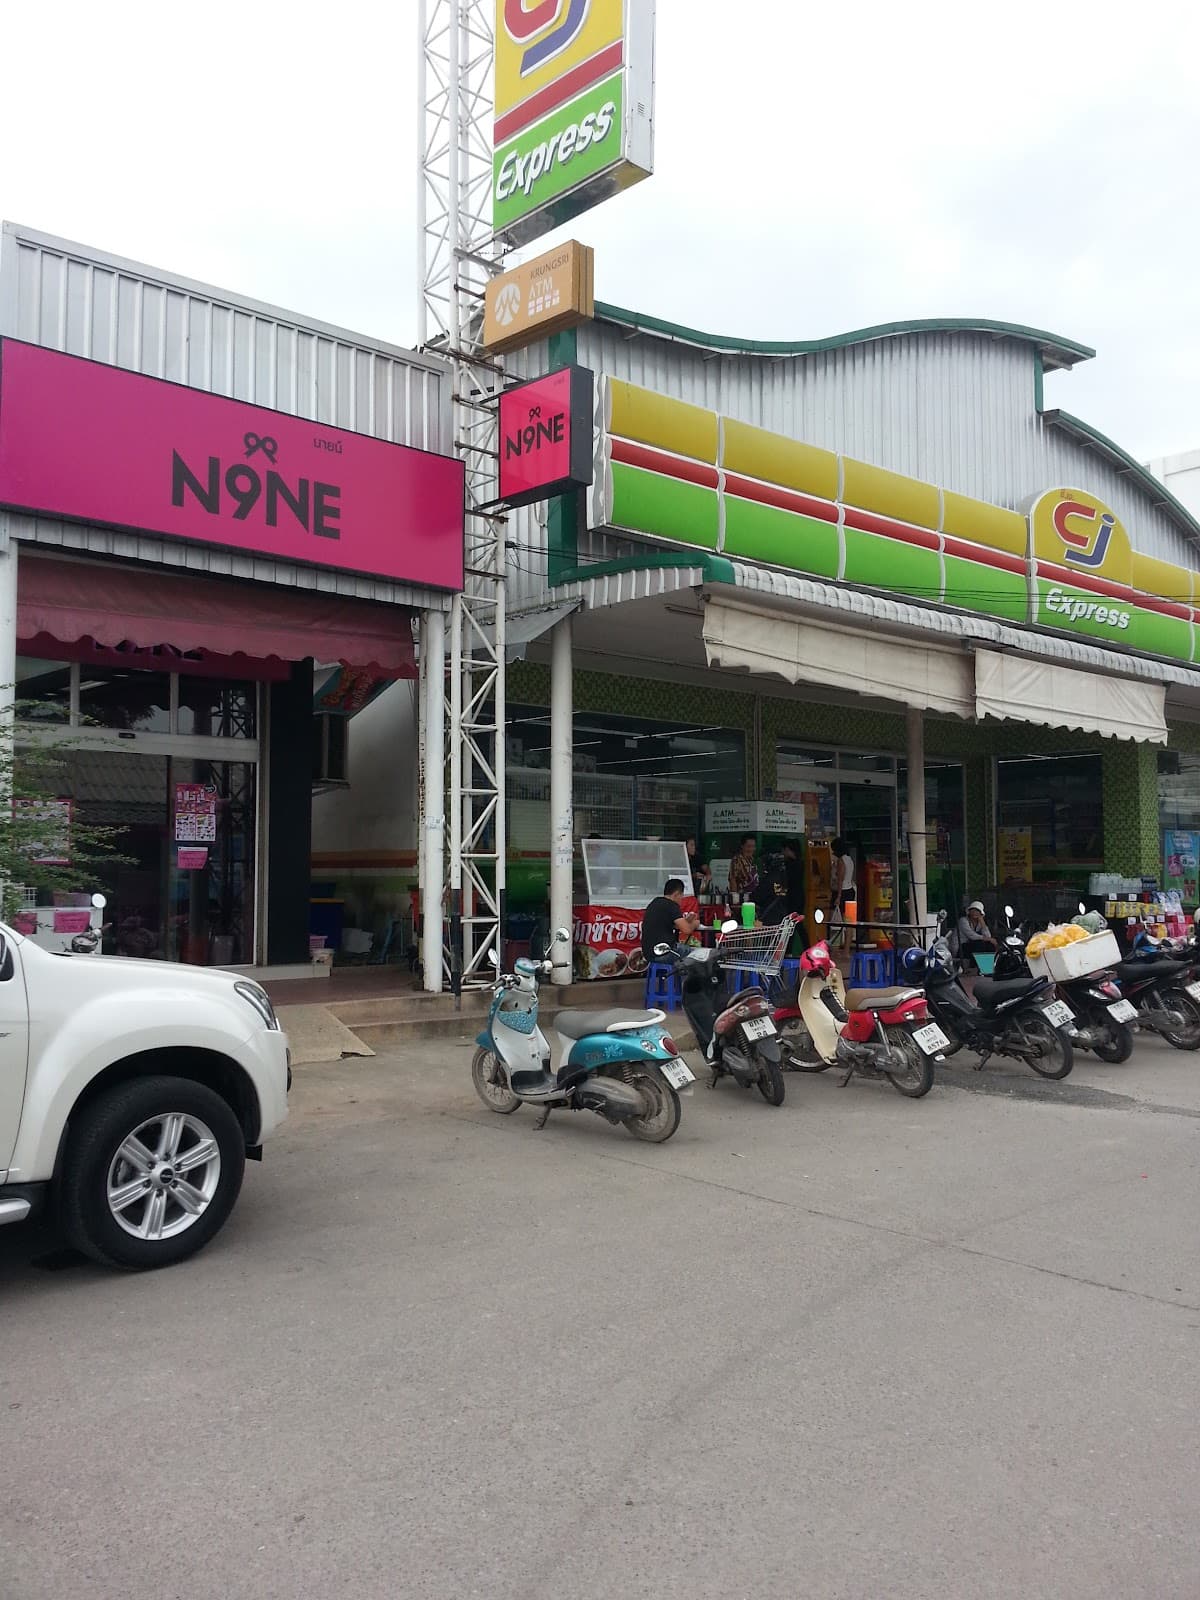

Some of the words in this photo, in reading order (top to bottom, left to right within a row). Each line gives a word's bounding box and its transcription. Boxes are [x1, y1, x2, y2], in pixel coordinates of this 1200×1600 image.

[495, 101, 615, 200] Express
[529, 276, 553, 299] ATM
[530, 253, 569, 280] KRUNGSRI
[506, 413, 564, 460] N9NE
[172, 448, 341, 540] N9NE
[1046, 587, 1130, 629] Express
